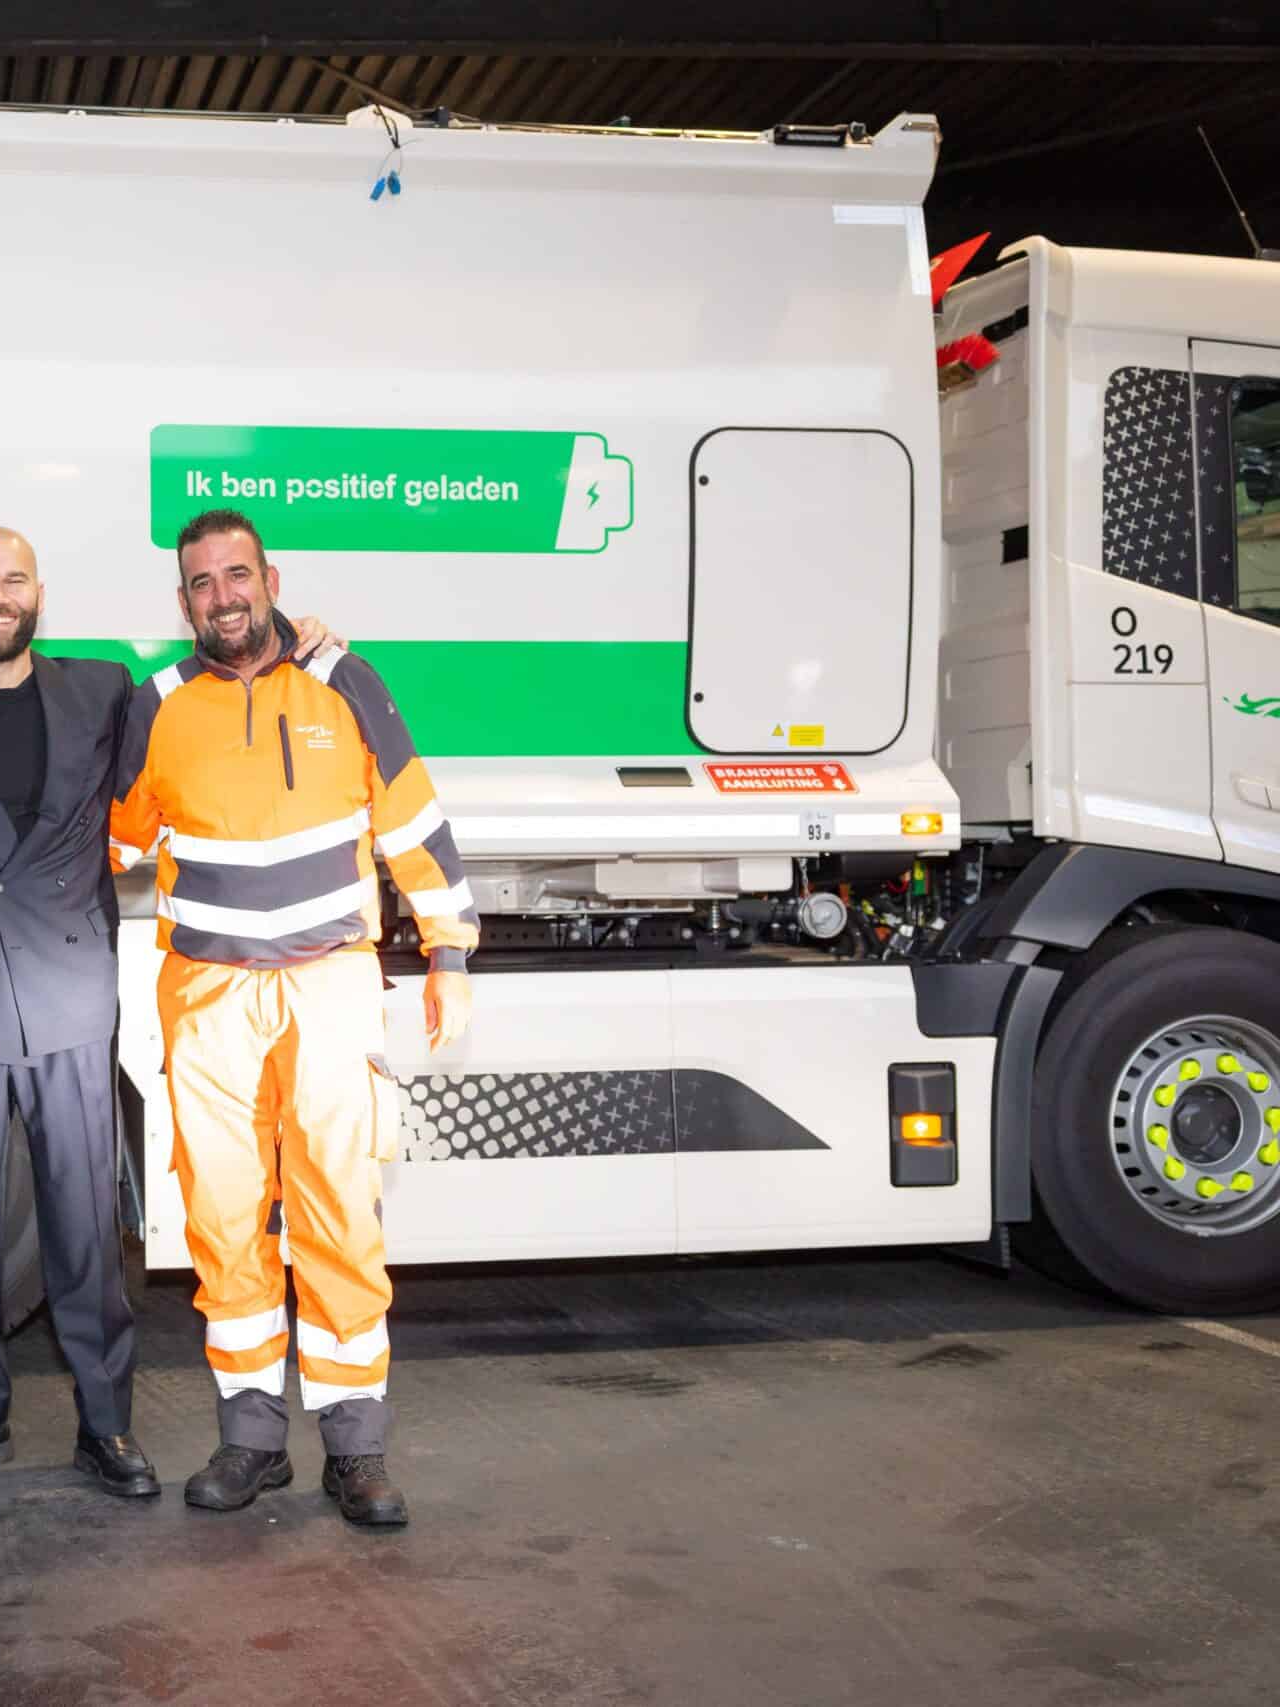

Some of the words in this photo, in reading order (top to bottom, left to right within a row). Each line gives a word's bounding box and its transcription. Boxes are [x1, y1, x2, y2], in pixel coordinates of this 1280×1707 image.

[186, 470, 212, 497] Ik
[221, 471, 276, 498] ben
[286, 473, 397, 505] positief
[404, 474, 519, 507] geladen
[1112, 643, 1174, 675] 219
[714, 767, 817, 778] BRANDWEER
[723, 778, 825, 789] AANSLUITING
[807, 823, 822, 841] 93
